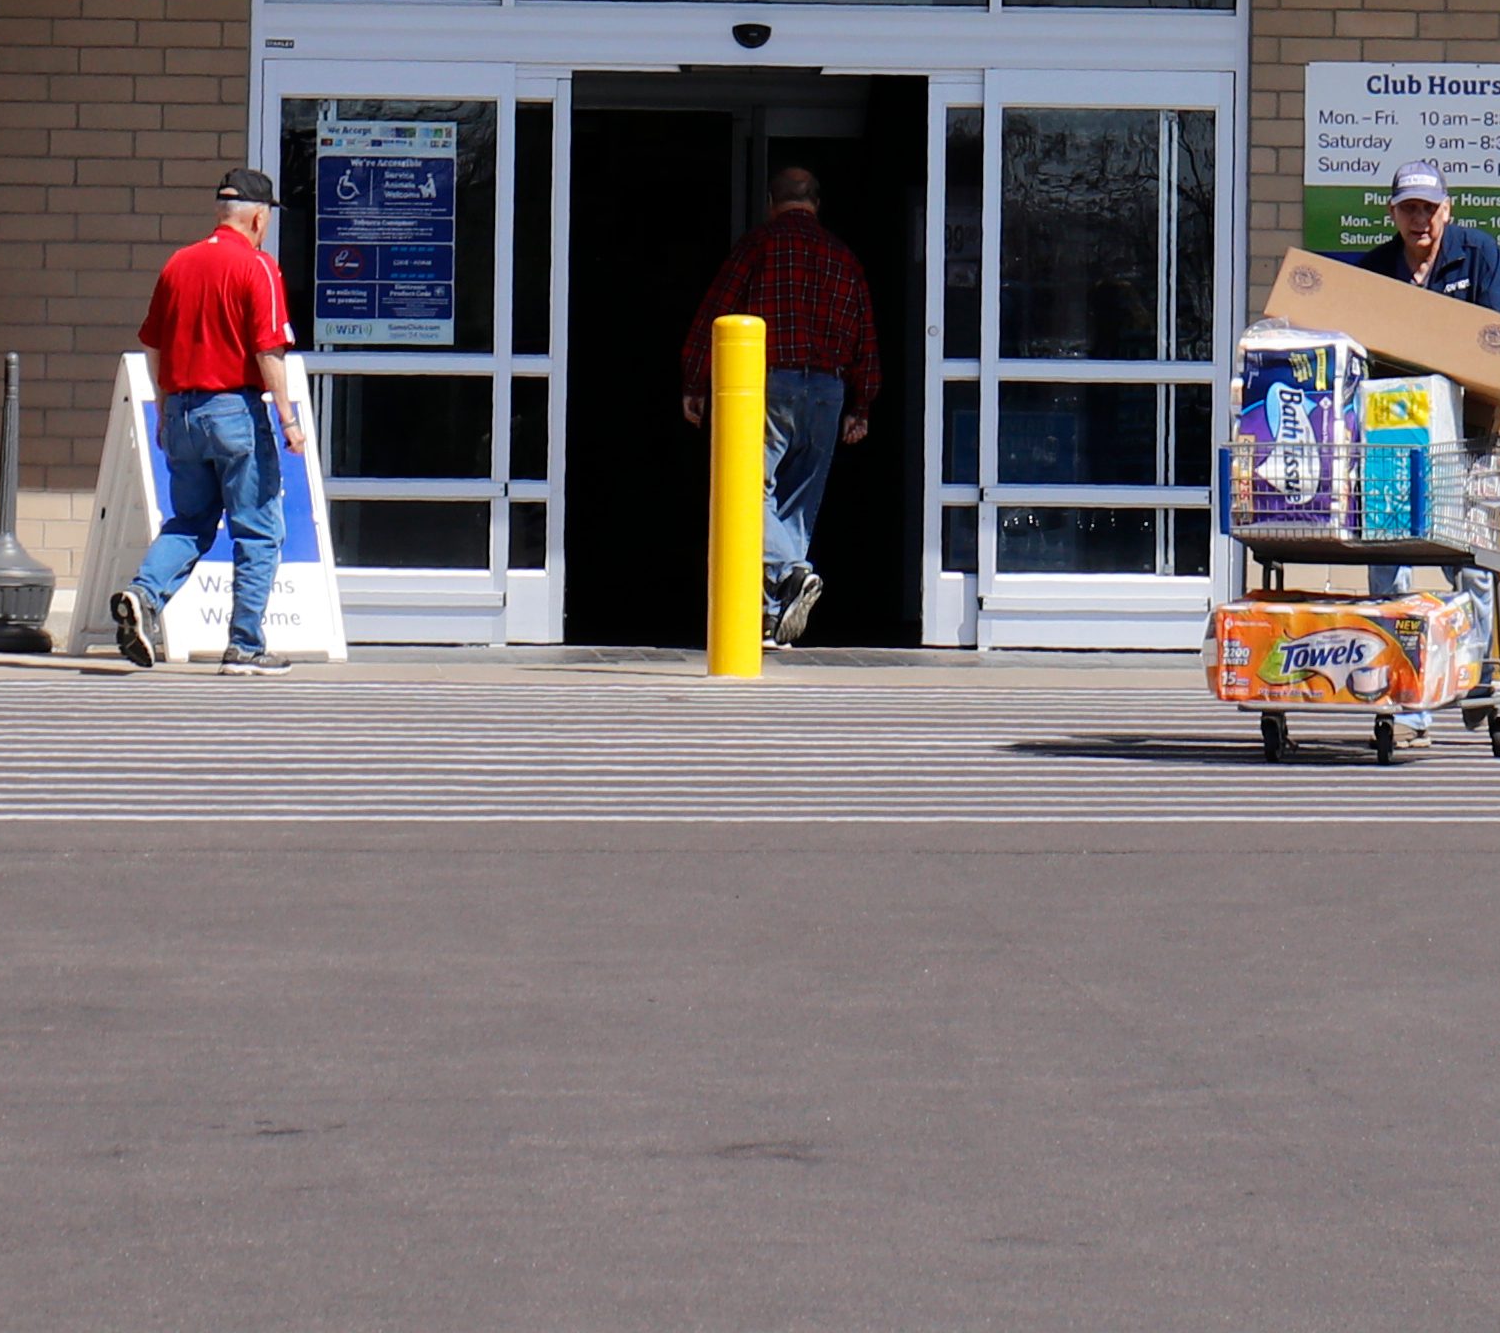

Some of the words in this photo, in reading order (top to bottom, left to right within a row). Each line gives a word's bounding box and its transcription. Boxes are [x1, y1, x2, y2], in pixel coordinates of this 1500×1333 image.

[1366, 74, 1422, 95] Club
[1318, 110, 1359, 125] Mon.
[1375, 110, 1399, 126] Fri.
[1419, 111, 1439, 126] 10
[1442, 114, 1468, 126] am
[1318, 133, 1392, 153] Saturday
[1425, 135, 1435, 149] 9
[1439, 138, 1465, 150] am
[1317, 157, 1380, 176] Sunday
[1443, 162, 1468, 173] am
[1484, 159, 1494, 173] 6
[1341, 216, 1371, 227] Mon.
[1457, 219, 1477, 228] am
[1280, 390, 1304, 440] Bath
[1395, 619, 1421, 630] NEW
[1223, 647, 1250, 658] 2200
[1280, 639, 1366, 673] Towels
[1222, 671, 1237, 685] 15
